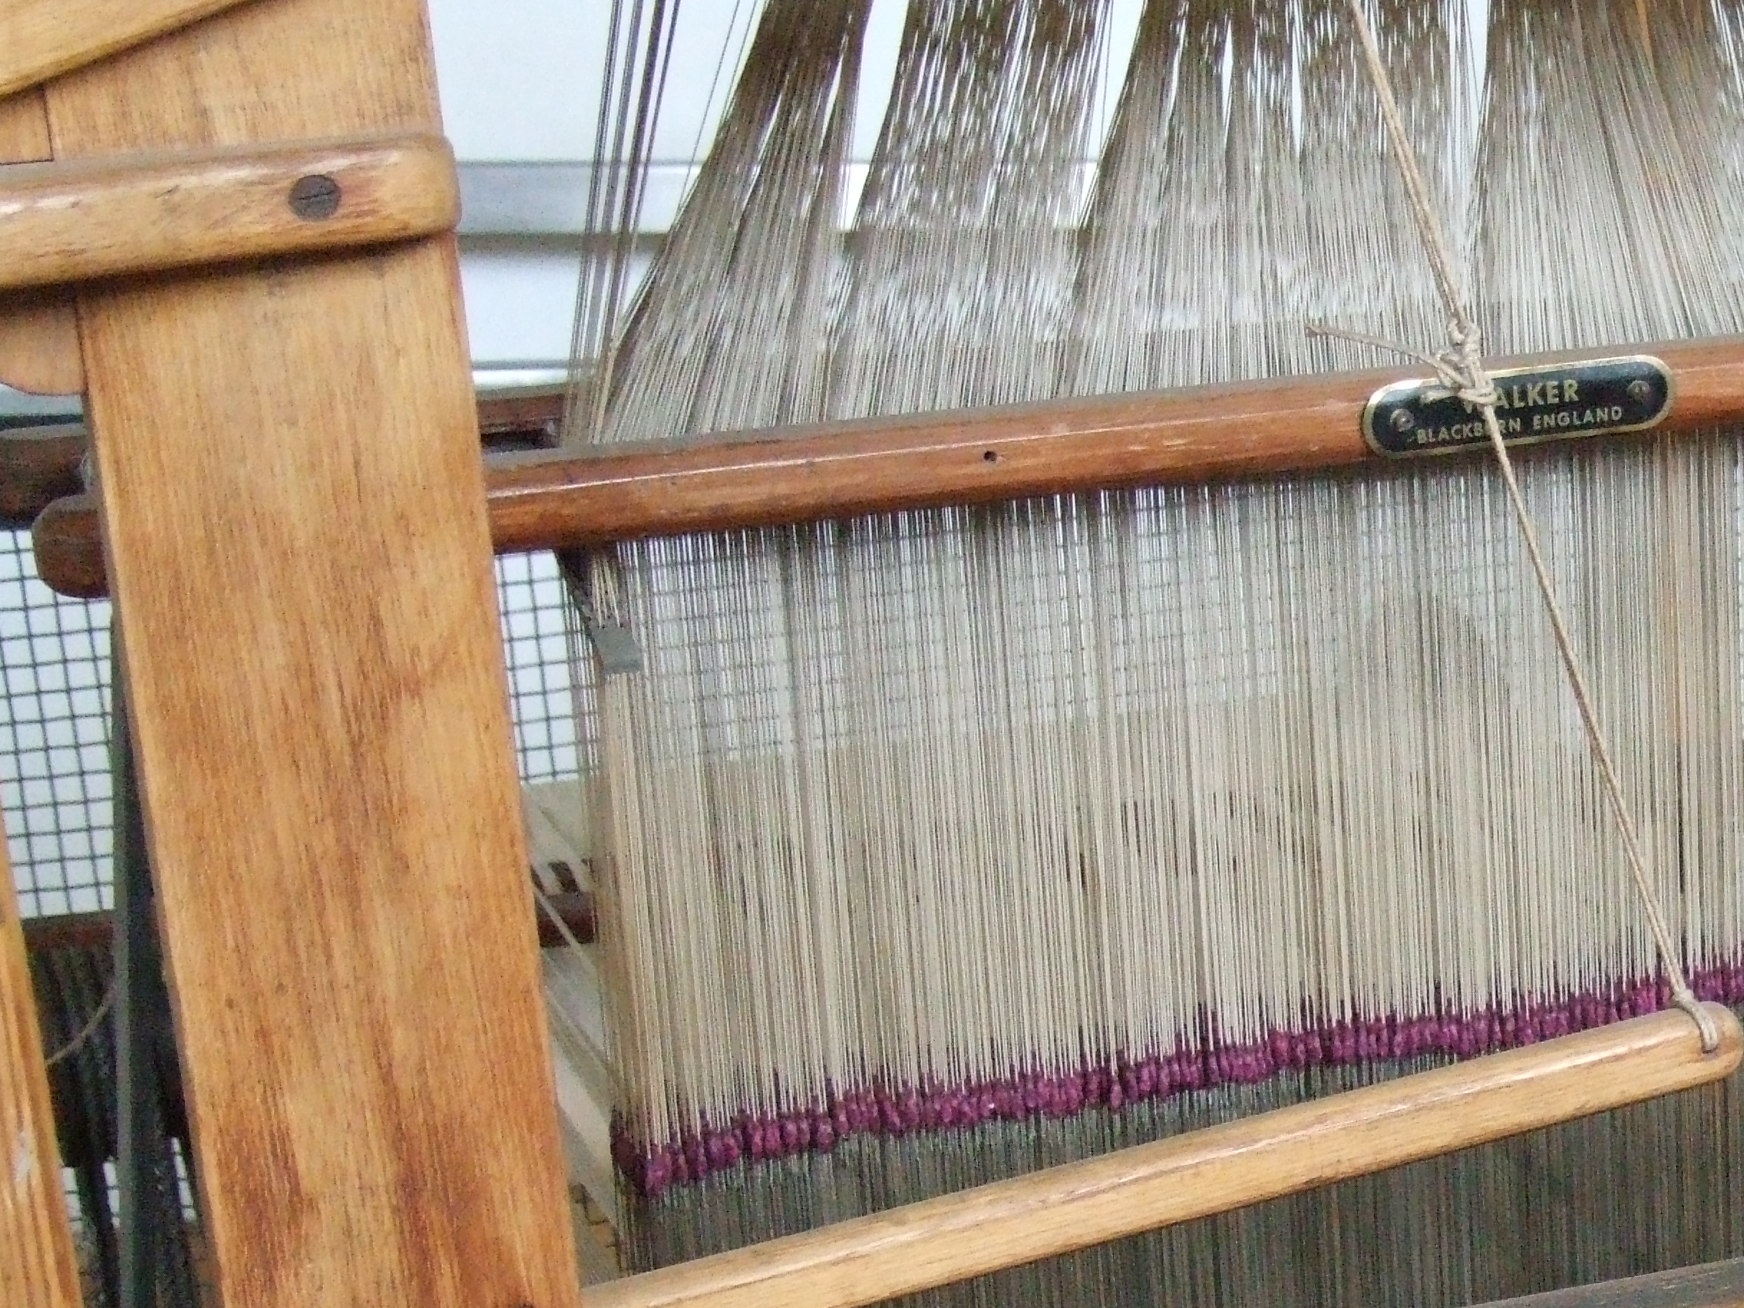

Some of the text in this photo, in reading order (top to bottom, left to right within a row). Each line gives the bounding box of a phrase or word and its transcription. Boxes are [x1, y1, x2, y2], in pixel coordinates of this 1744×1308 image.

[1461, 379, 1579, 414] ALKER
[1417, 405, 1623, 444] BLACKBRN ENGLAND
